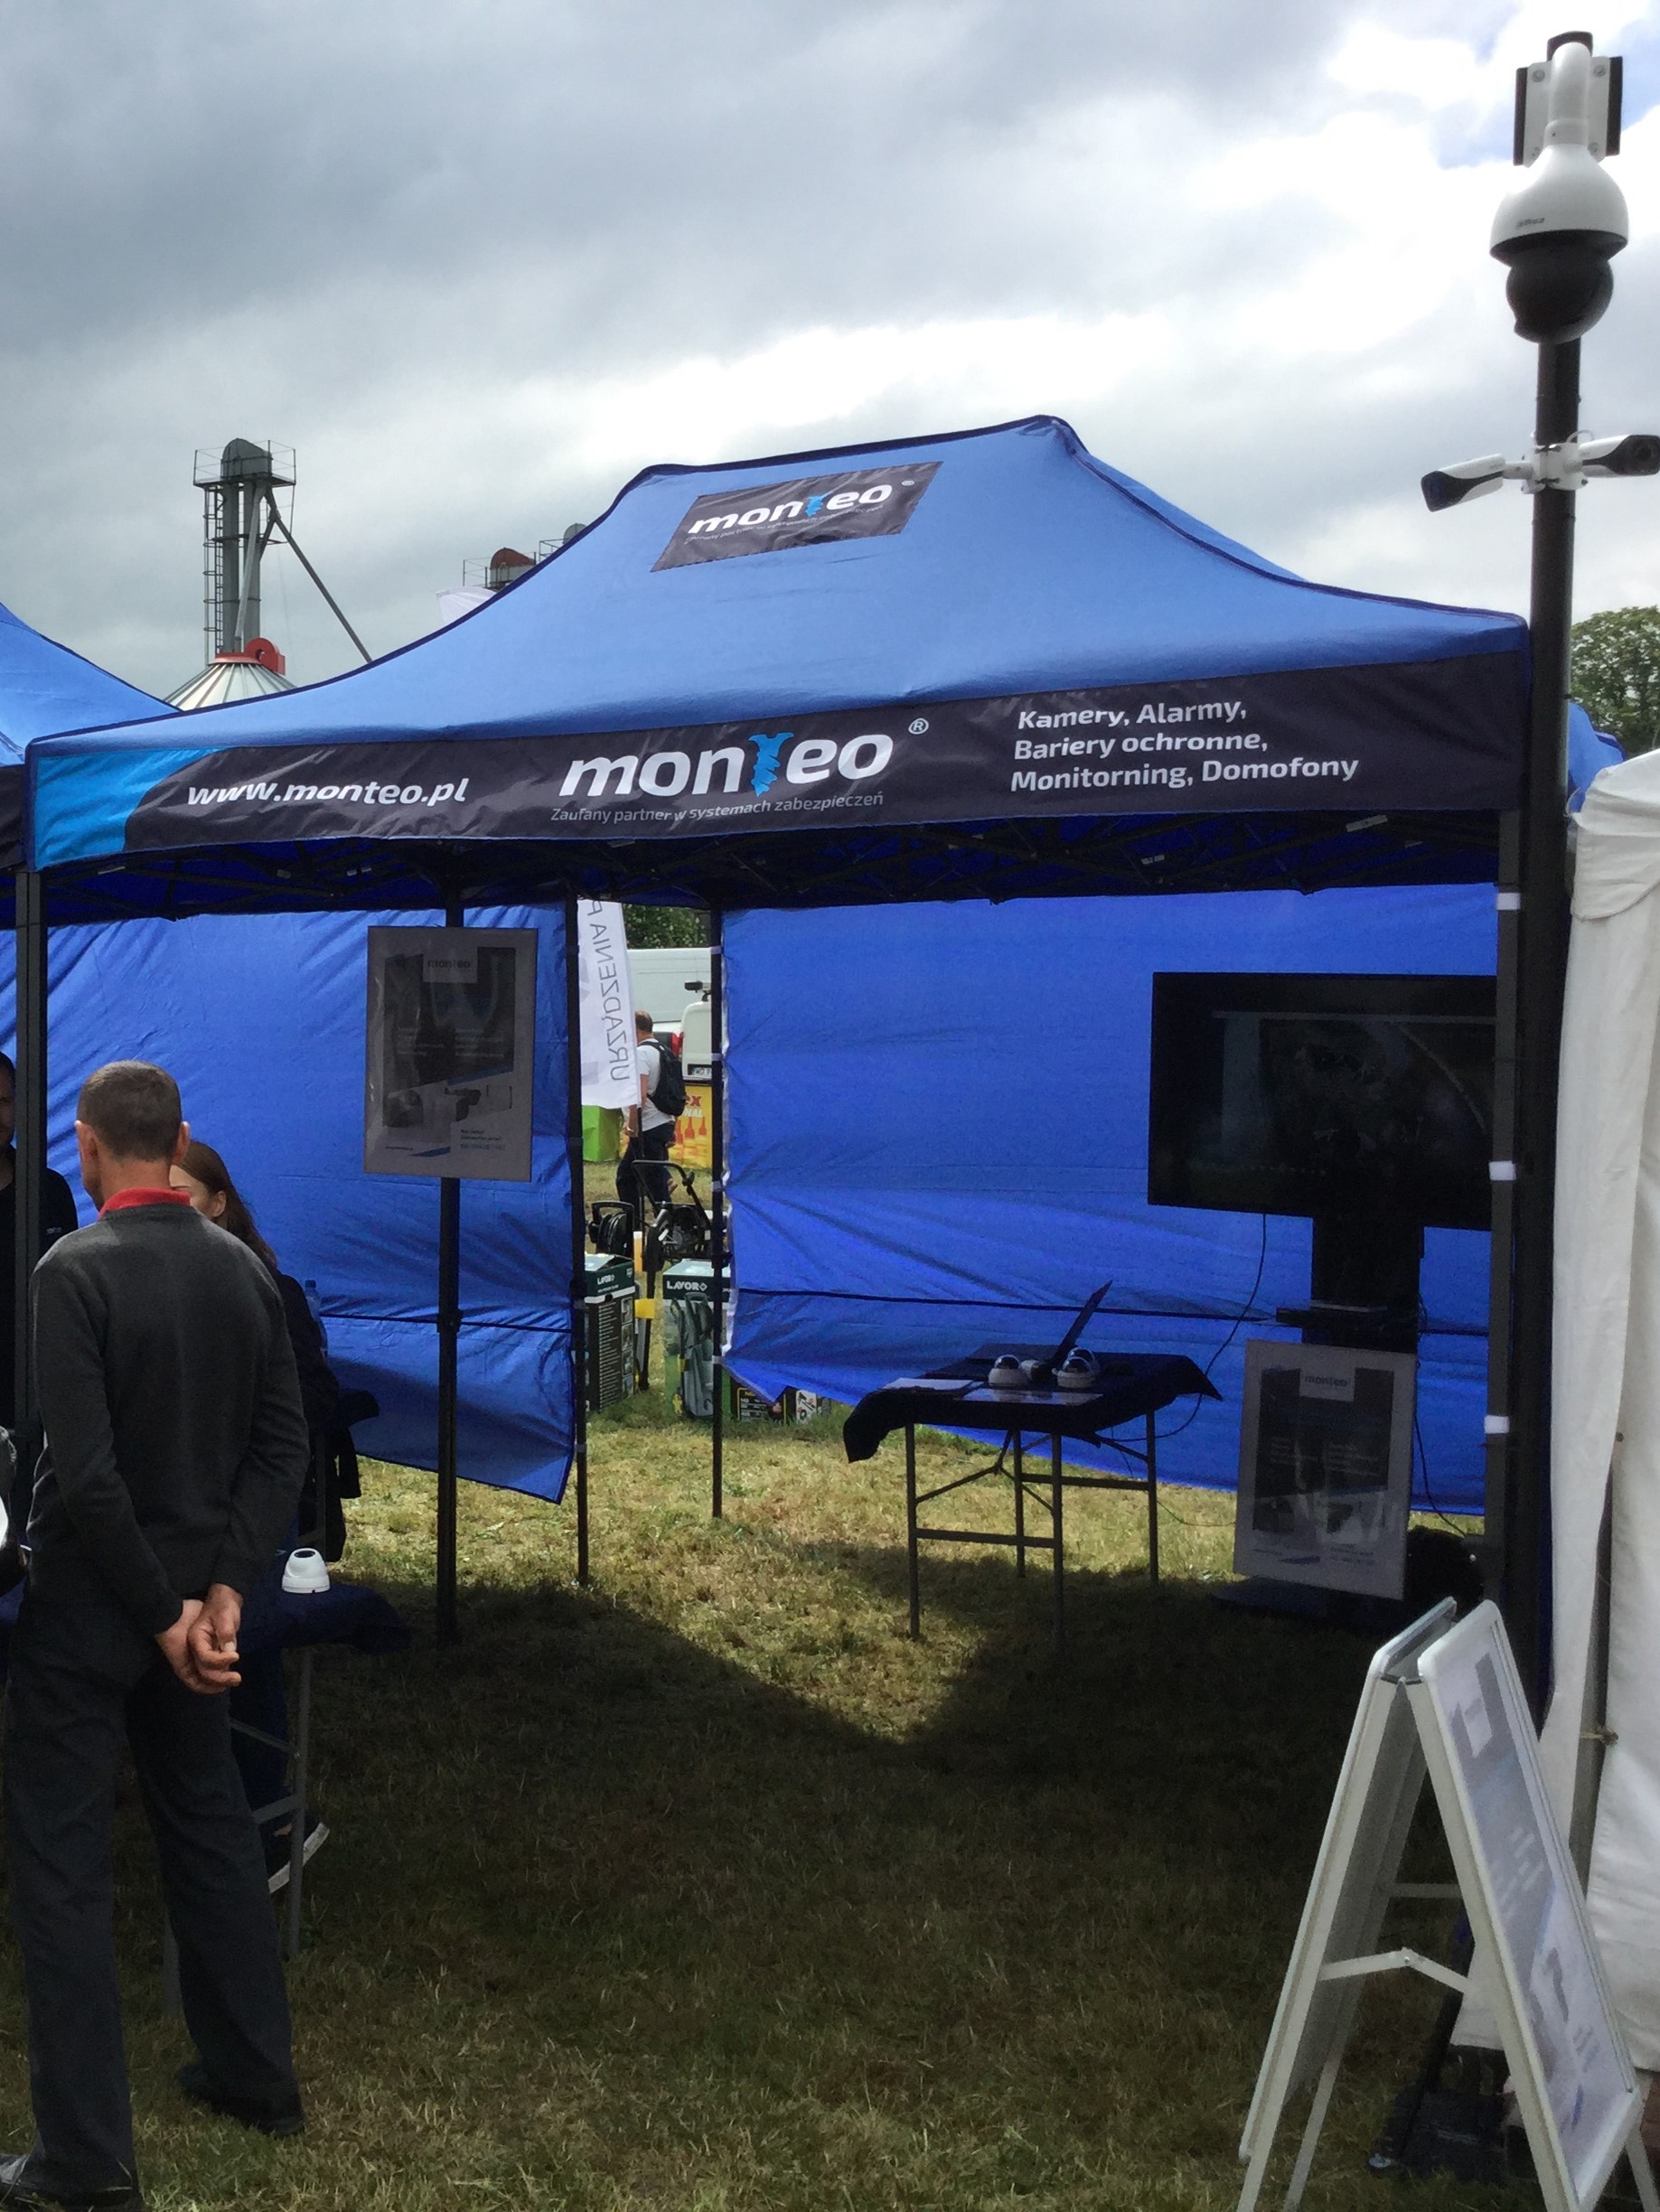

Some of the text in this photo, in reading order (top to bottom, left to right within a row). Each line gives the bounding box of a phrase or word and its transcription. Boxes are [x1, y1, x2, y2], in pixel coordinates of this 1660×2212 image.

[688, 483, 893, 534] monteo
[1018, 699, 1247, 730] Kamery, Alarmy,
[1014, 732, 1269, 760] Bariery ochronne,
[558, 732, 894, 797] monteo
[1010, 756, 1360, 792] Monitorning, Domofony
[187, 778, 470, 807] www.monteo.pl
[550, 791, 885, 824] Zaufany partner w systemach zabezpieczeń
